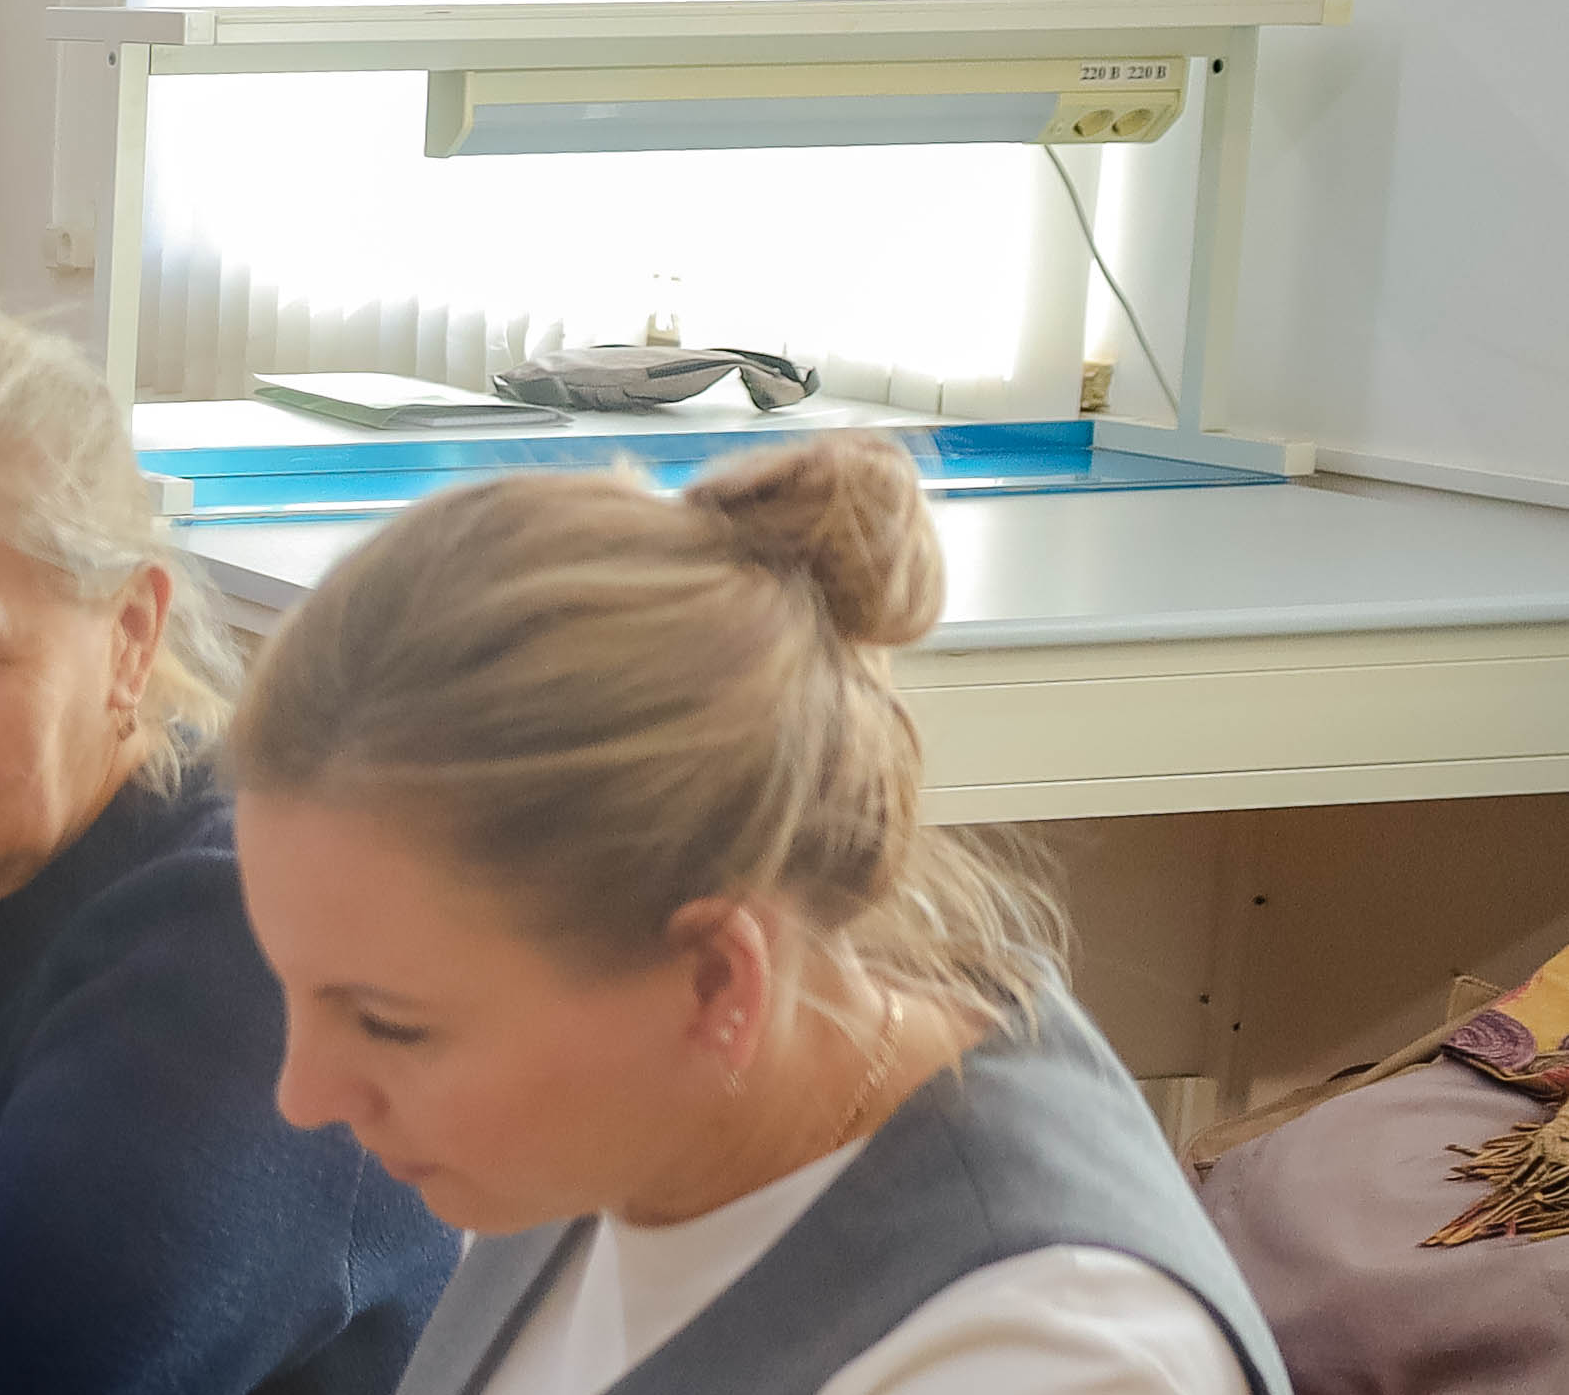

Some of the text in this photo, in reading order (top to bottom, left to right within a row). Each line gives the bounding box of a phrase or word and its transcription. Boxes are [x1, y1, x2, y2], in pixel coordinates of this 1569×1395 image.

[1080, 66, 1166, 80] 220 В 220 В
